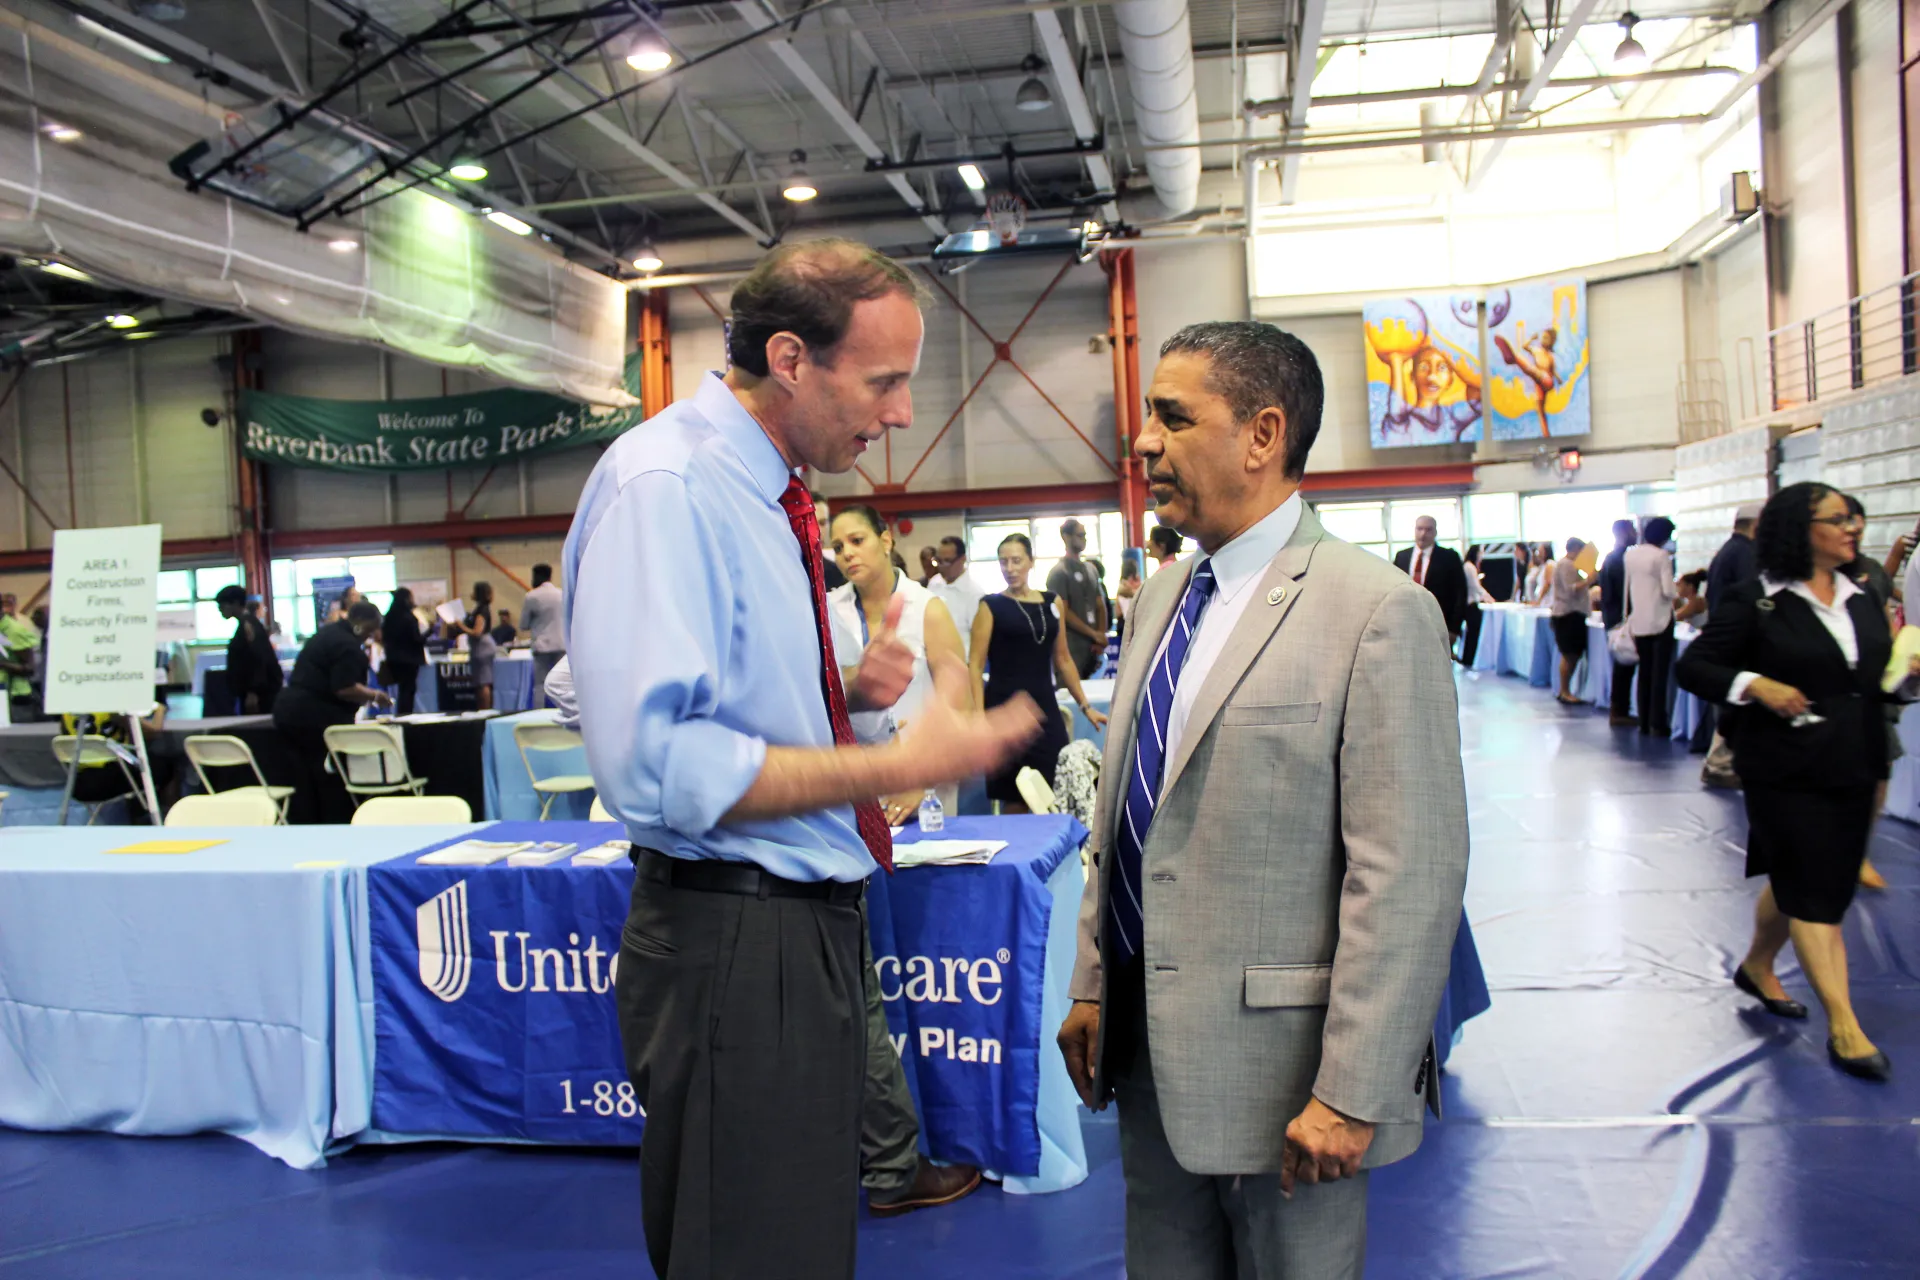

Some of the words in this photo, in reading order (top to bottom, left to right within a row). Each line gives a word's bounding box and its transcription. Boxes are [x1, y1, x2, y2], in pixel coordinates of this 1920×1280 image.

[377, 411, 458, 430] Welcome
[463, 407, 485, 426] To
[244, 420, 396, 466] Riverbank
[406, 434, 489, 465] State
[496, 409, 574, 456] Park
[83, 558, 118, 572] AREA
[66, 575, 146, 591] Construction
[60, 614, 112, 629] Security
[115, 612, 148, 625] Firms
[92, 633, 117, 645] and
[85, 652, 122, 666] Large
[58, 669, 144, 685] Organizations
[919, 1026, 1002, 1064] Plan
[559, 1078, 648, 1119] 1-88
